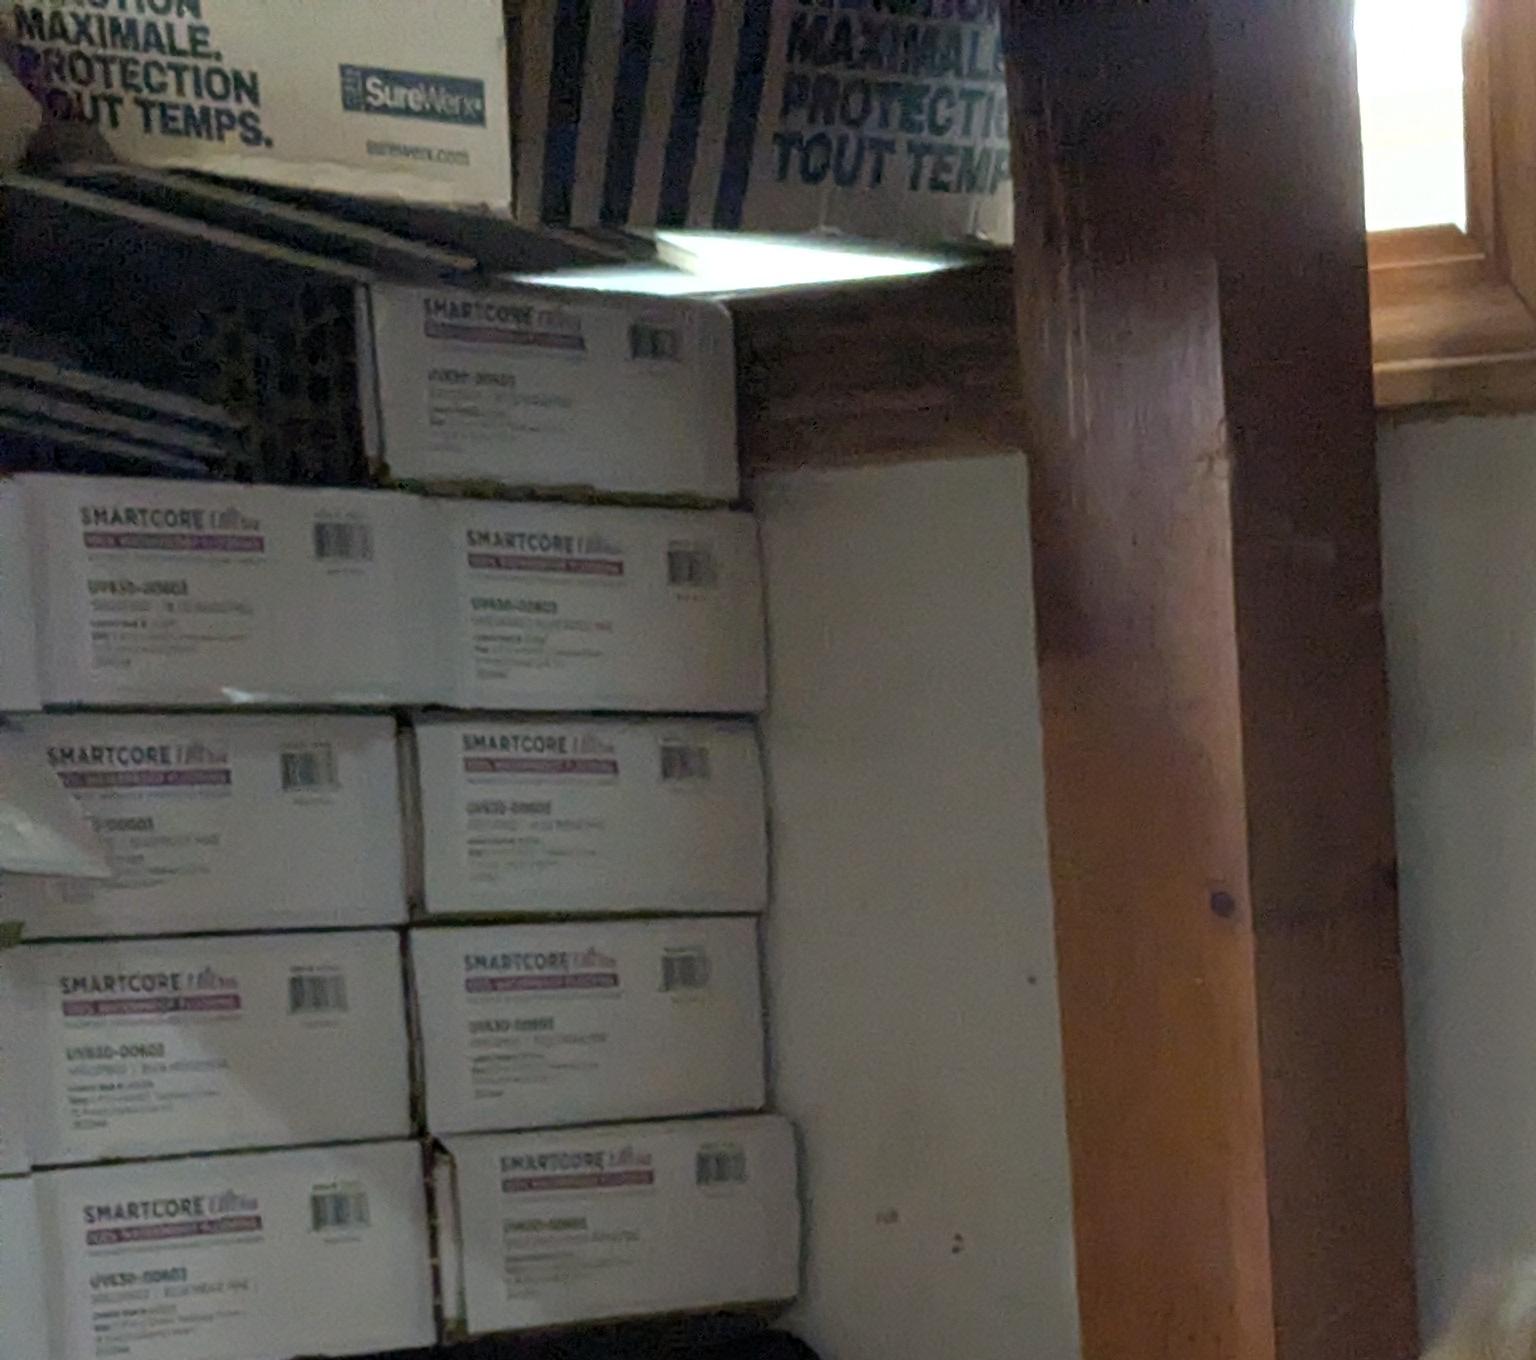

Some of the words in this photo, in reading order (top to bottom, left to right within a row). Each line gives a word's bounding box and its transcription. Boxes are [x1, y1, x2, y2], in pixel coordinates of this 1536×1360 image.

[14, 4, 223, 62] MAXIMALE.
[46, 86, 124, 129] OUT
[134, 98, 275, 149] TEMPS.
[773, 131, 896, 188] TOUT
[80, 506, 204, 530] SMARTCORE
[466, 528, 574, 553] SMARTCORE
[47, 744, 172, 766] SMARTCORE
[462, 733, 568, 754] SMARTCORE
[464, 951, 569, 973] SMARTCORE
[60, 972, 182, 995] SMARTCORE
[83, 1196, 205, 1224] SMARTCORE
